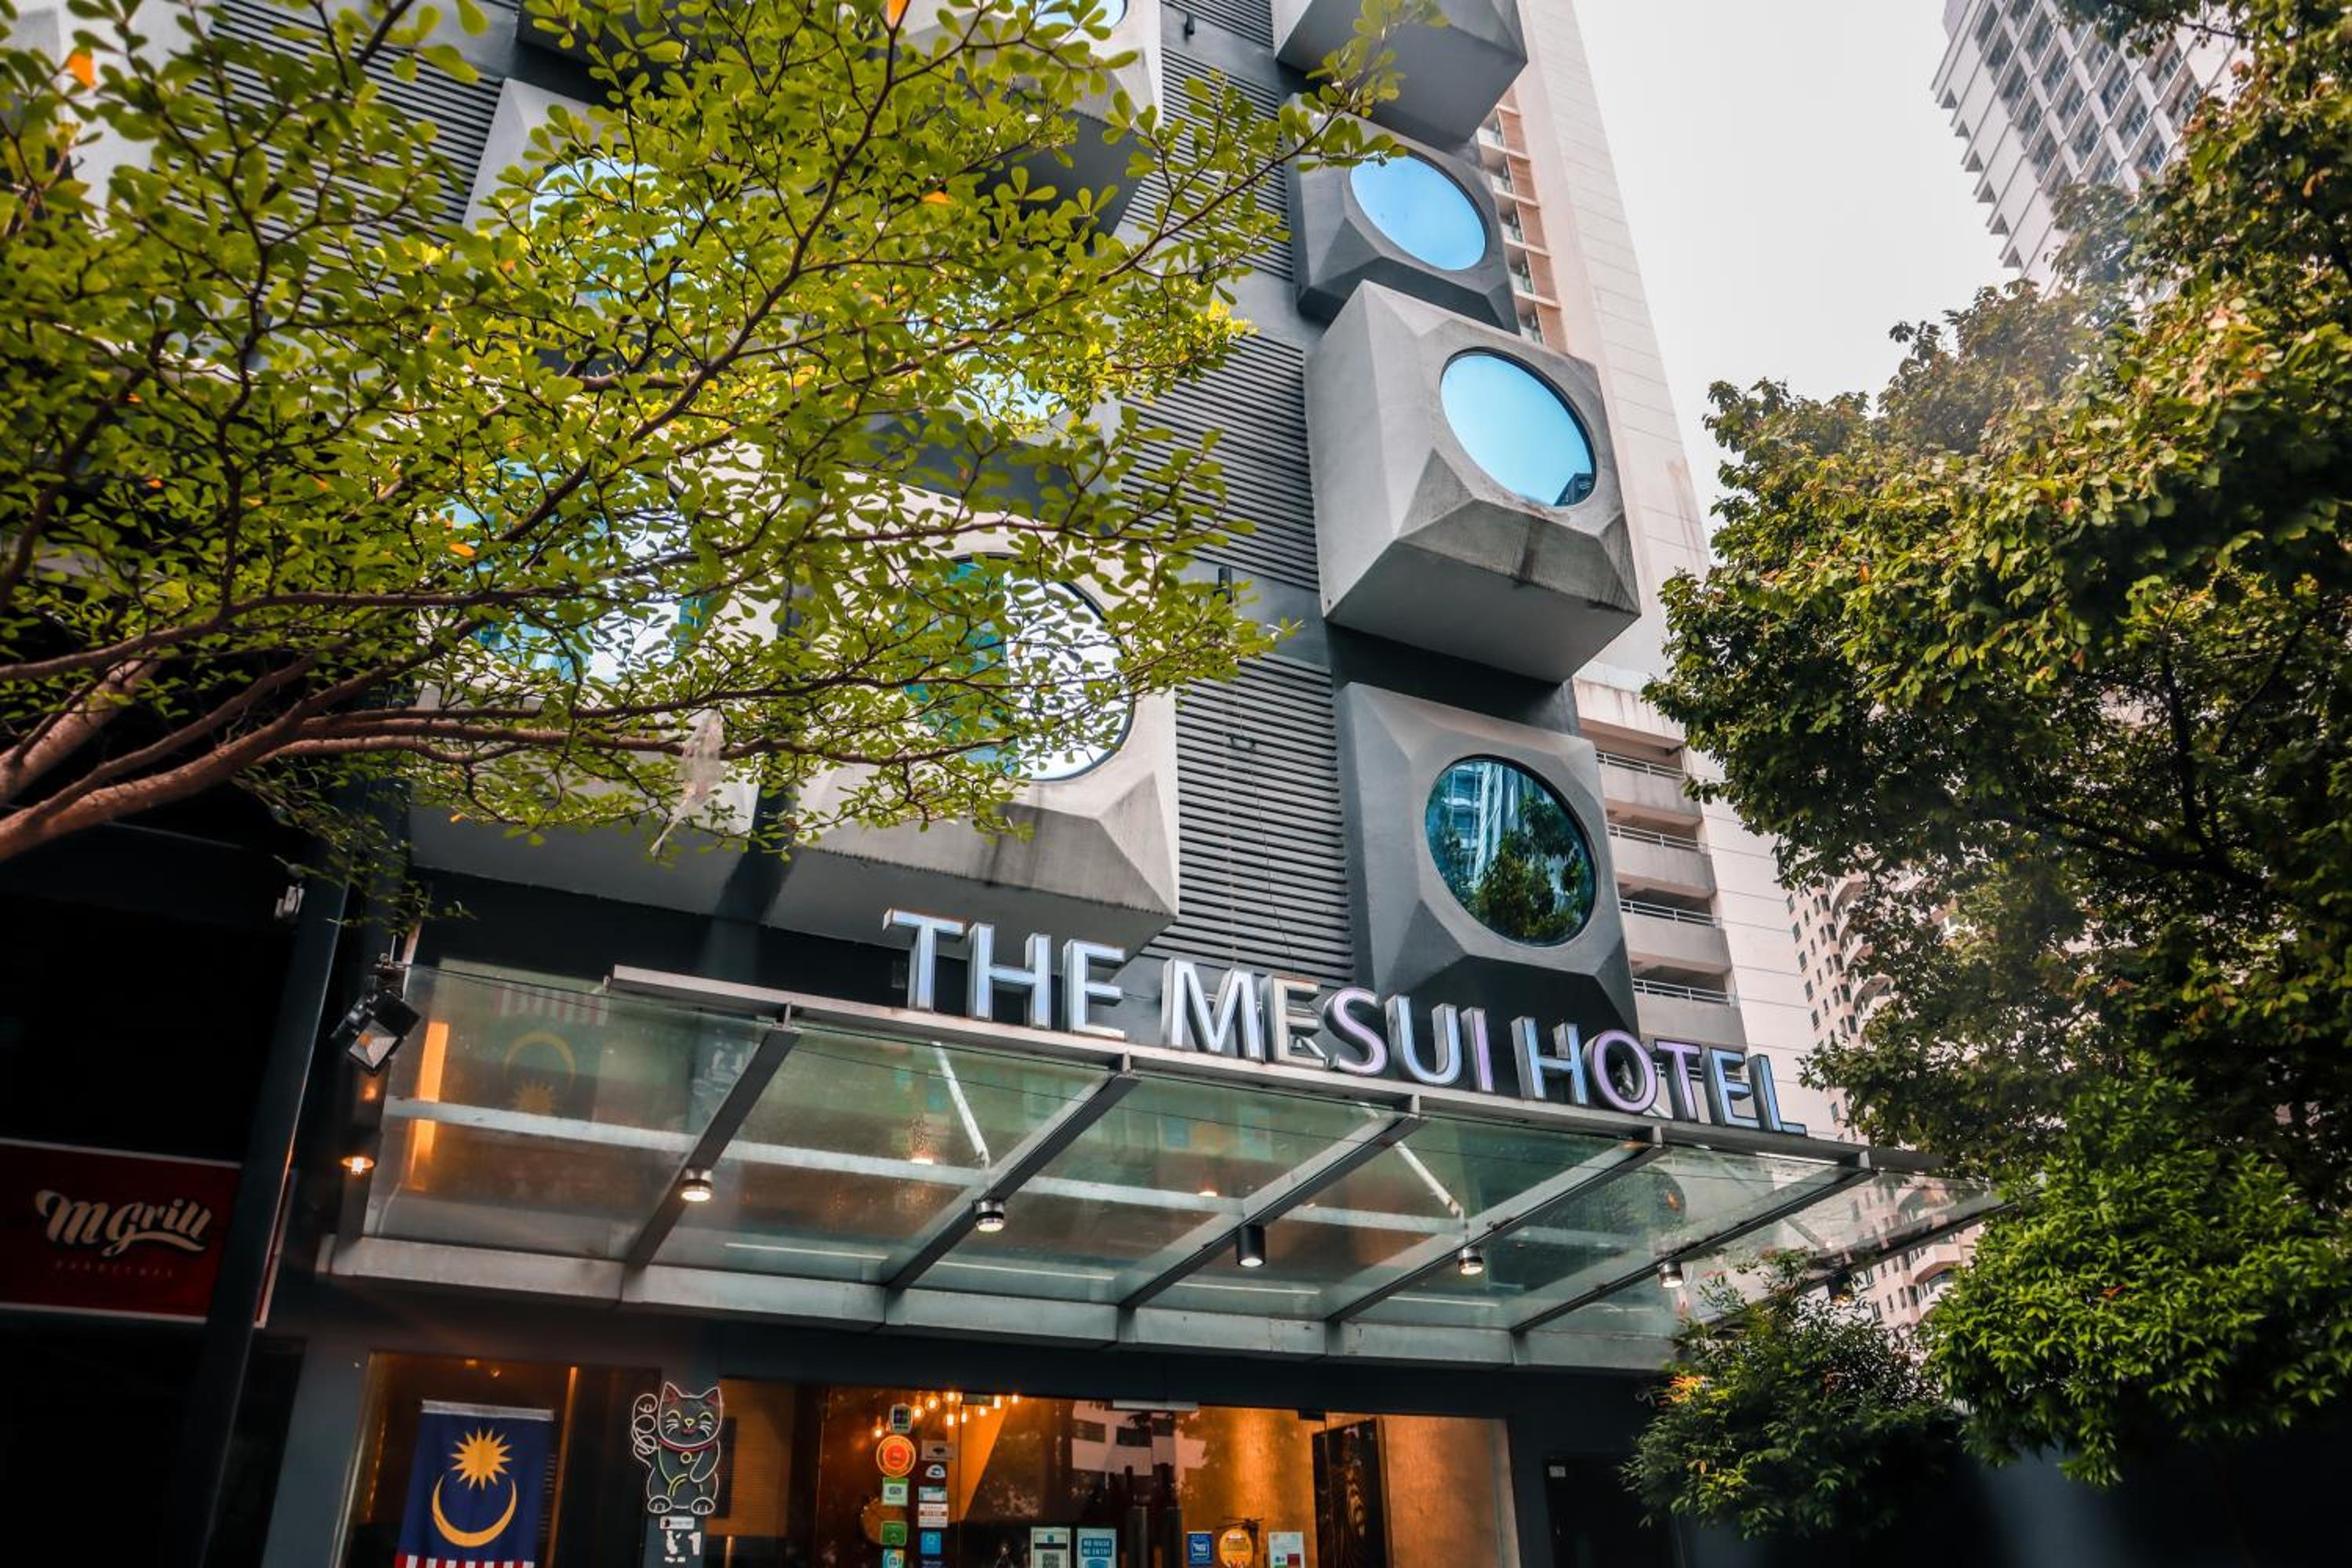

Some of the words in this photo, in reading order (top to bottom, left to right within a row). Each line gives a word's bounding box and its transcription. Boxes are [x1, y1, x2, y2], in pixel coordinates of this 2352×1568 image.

[884, 908, 1126, 1040] THE
[1160, 956, 1495, 1093] MESUI
[1510, 1015, 1806, 1137] HOTEL
